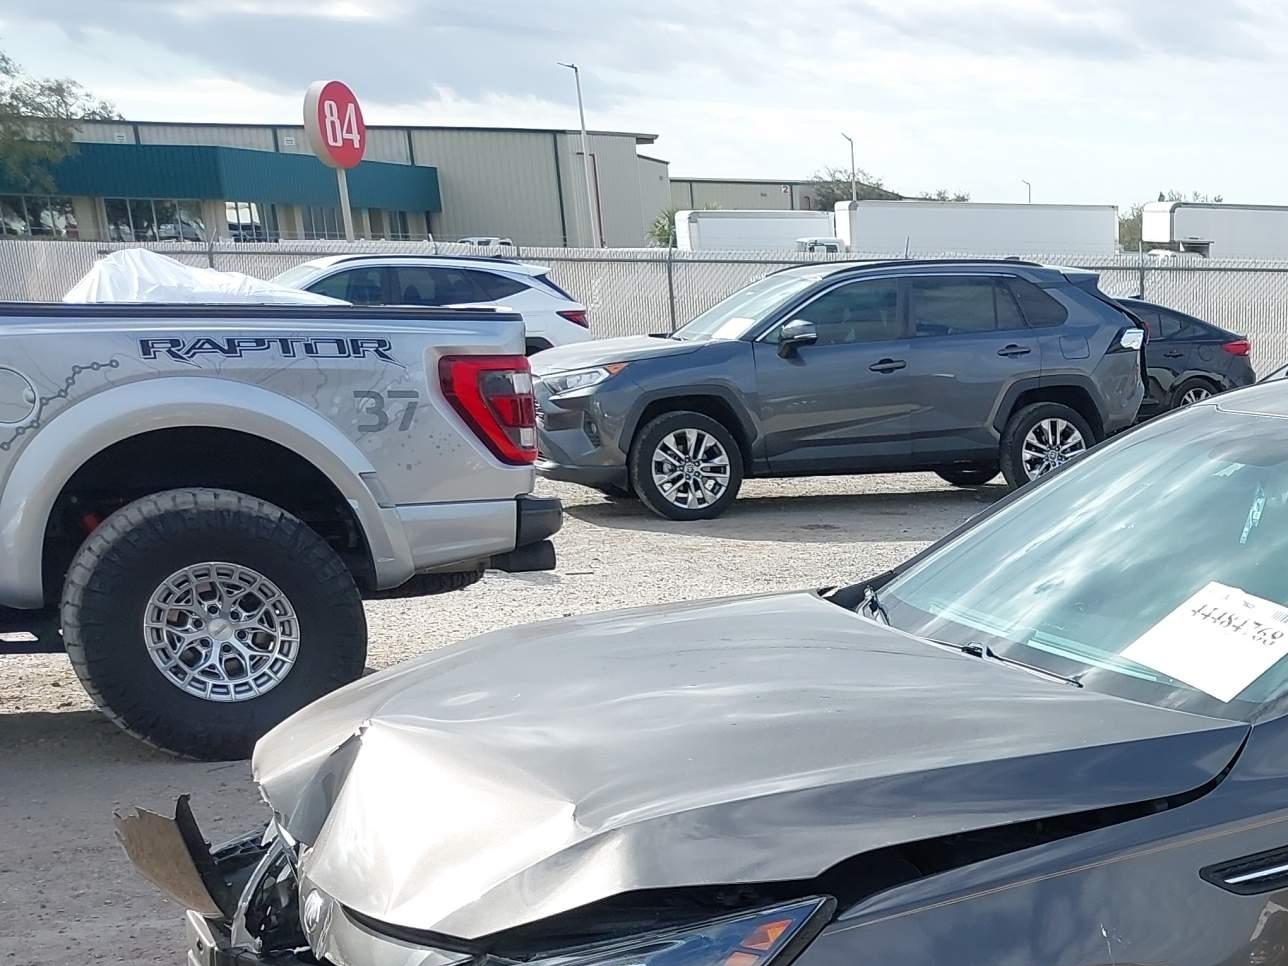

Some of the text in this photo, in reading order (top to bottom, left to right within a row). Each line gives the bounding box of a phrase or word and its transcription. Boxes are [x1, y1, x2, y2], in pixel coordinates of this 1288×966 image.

[323, 100, 361, 149] 84
[137, 336, 407, 368] RAPTOR
[353, 390, 419, 432] 37
